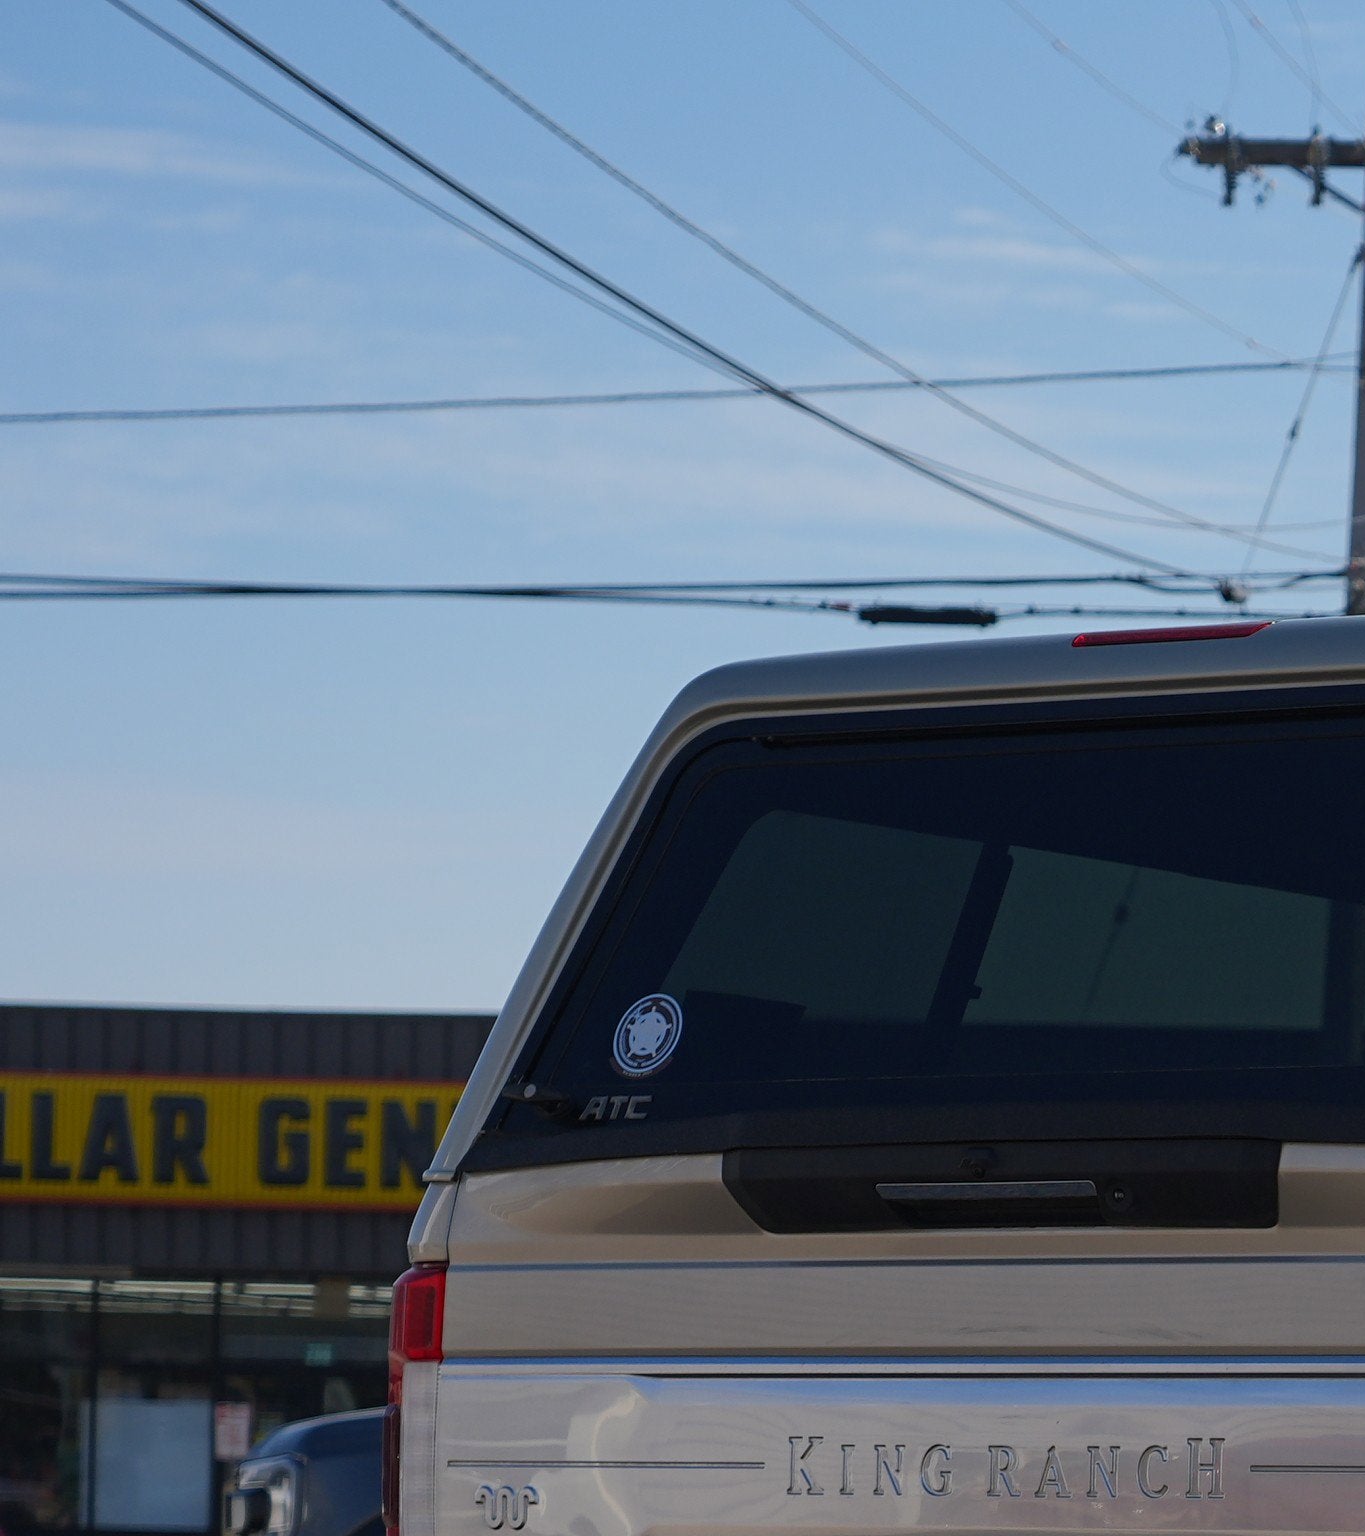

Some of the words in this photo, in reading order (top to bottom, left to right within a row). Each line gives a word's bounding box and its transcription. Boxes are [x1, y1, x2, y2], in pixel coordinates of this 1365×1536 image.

[578, 1095, 653, 1120] ATC
[257, 1094, 460, 1190] GEN
[786, 1435, 954, 1497] KING
[986, 1437, 1226, 1499] RANCH
